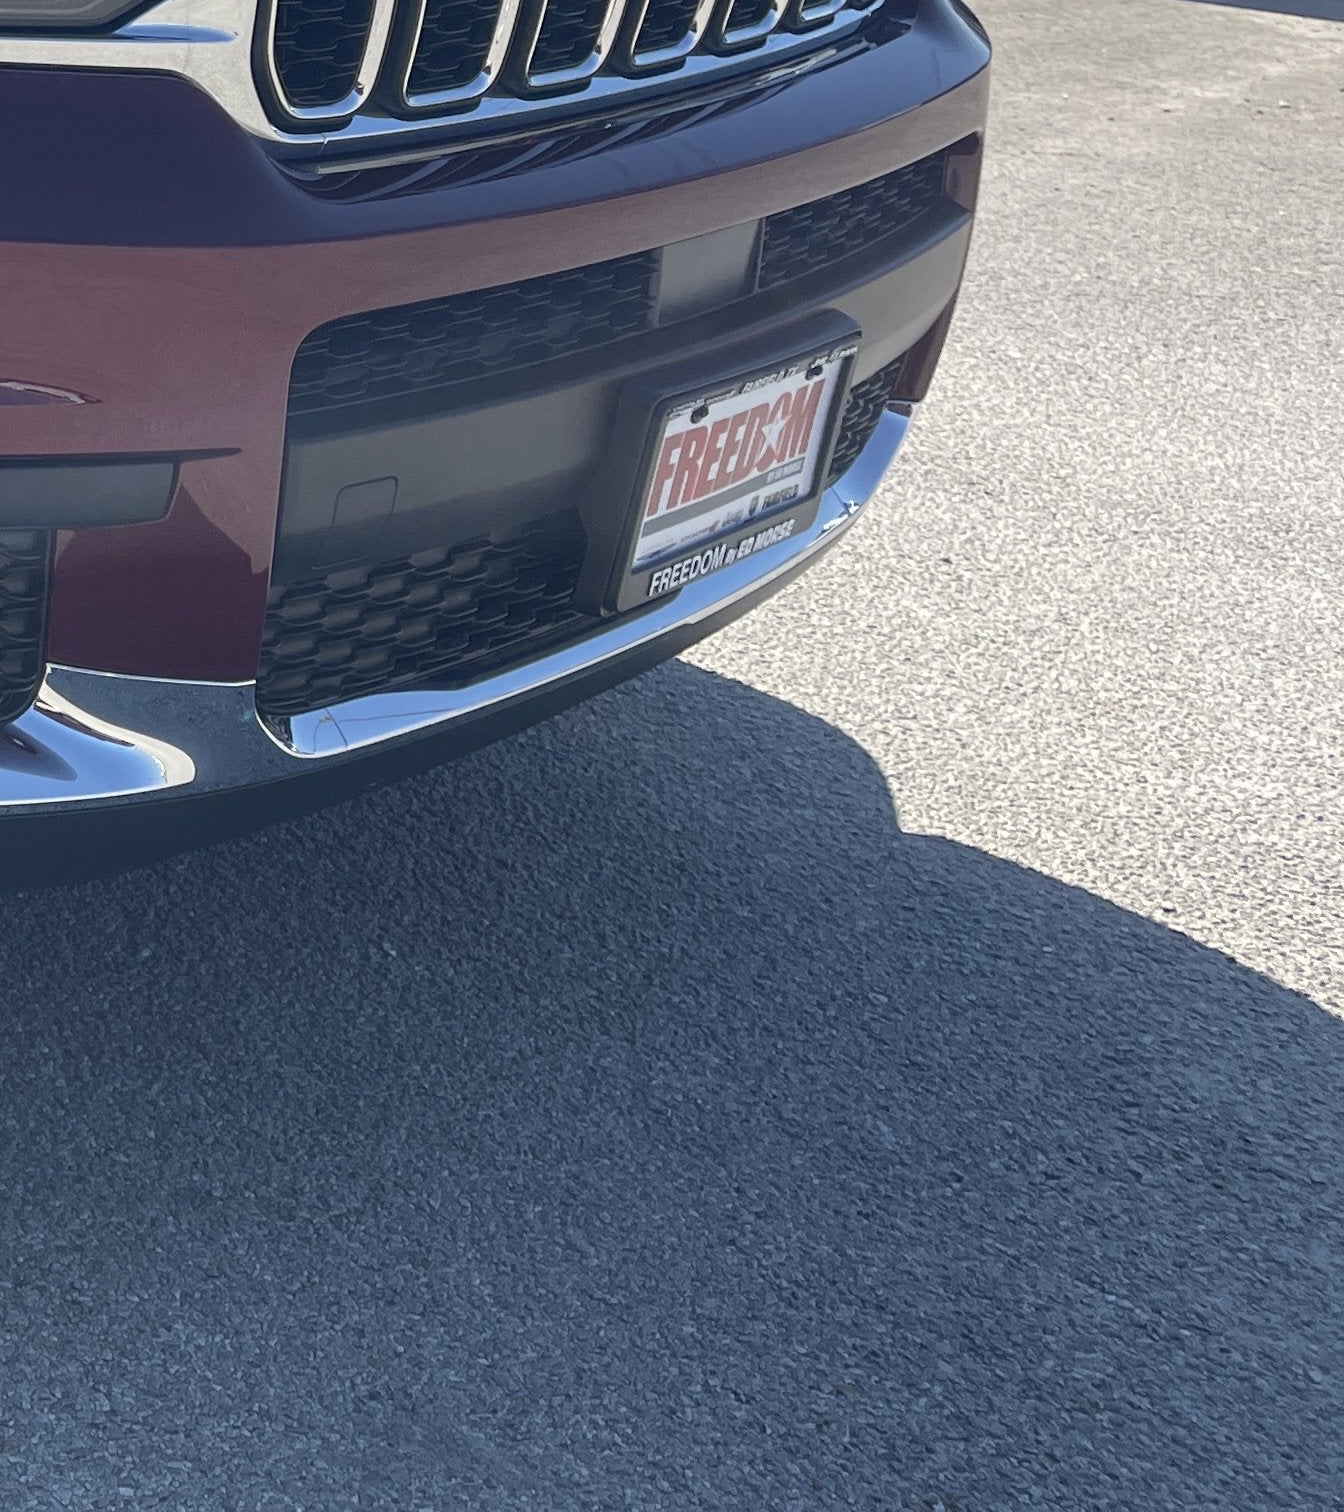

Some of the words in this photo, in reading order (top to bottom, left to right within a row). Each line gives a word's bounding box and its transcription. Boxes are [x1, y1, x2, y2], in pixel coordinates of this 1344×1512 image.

[646, 378, 826, 517] FREEDOM
[648, 543, 728, 597] FREEDOM
[736, 536, 755, 560] ED
[753, 518, 796, 551] MORSE
